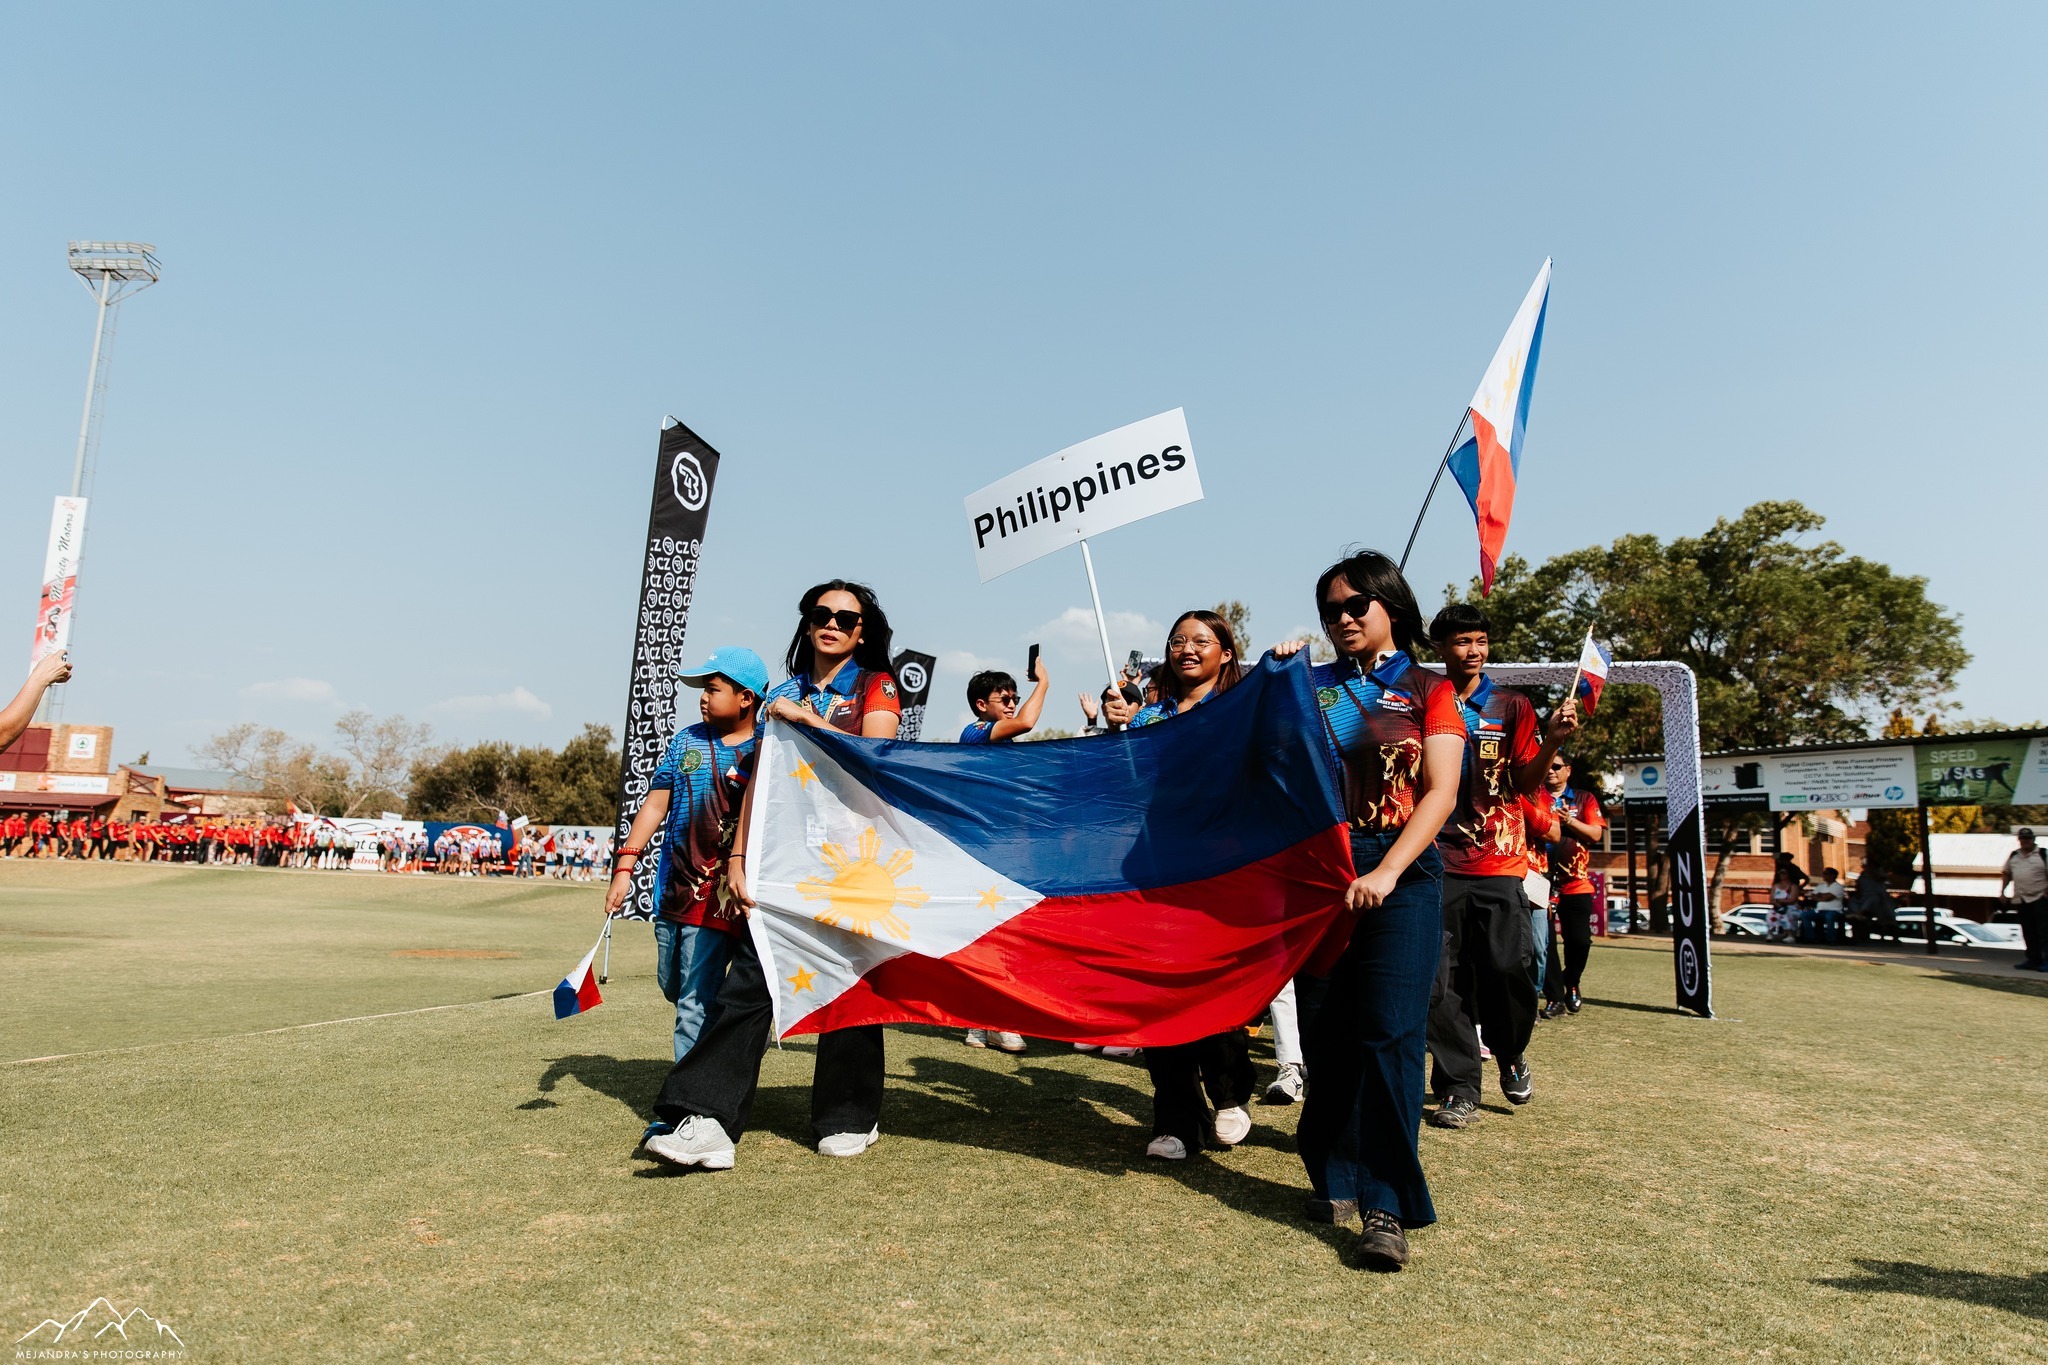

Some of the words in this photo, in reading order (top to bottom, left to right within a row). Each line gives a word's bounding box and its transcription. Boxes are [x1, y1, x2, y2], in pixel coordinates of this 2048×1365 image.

[973, 444, 1186, 549] Philippines
[57, 513, 74, 552] Motors
[675, 541, 689, 554] CZ
[656, 557, 671, 570] CZ
[684, 559, 696, 572] CZ
[650, 574, 662, 588] CZ
[676, 576, 689, 589] CZ
[658, 593, 671, 606] CZ
[650, 611, 662, 624] CZ
[656, 629, 669, 641] CZ
[649, 647, 661, 660] CZ
[656, 664, 668, 677] CZ
[633, 683, 649, 698] CZ
[644, 702, 656, 715] CZ
[660, 700, 673, 713] CZ
[637, 721, 652, 735] CZ
[646, 739, 663, 752] CZ
[1930, 748, 1977, 763] SPEED
[638, 758, 654, 772] CZ
[1931, 767, 1950, 780] BY
[1677, 851, 1693, 928] CZ
